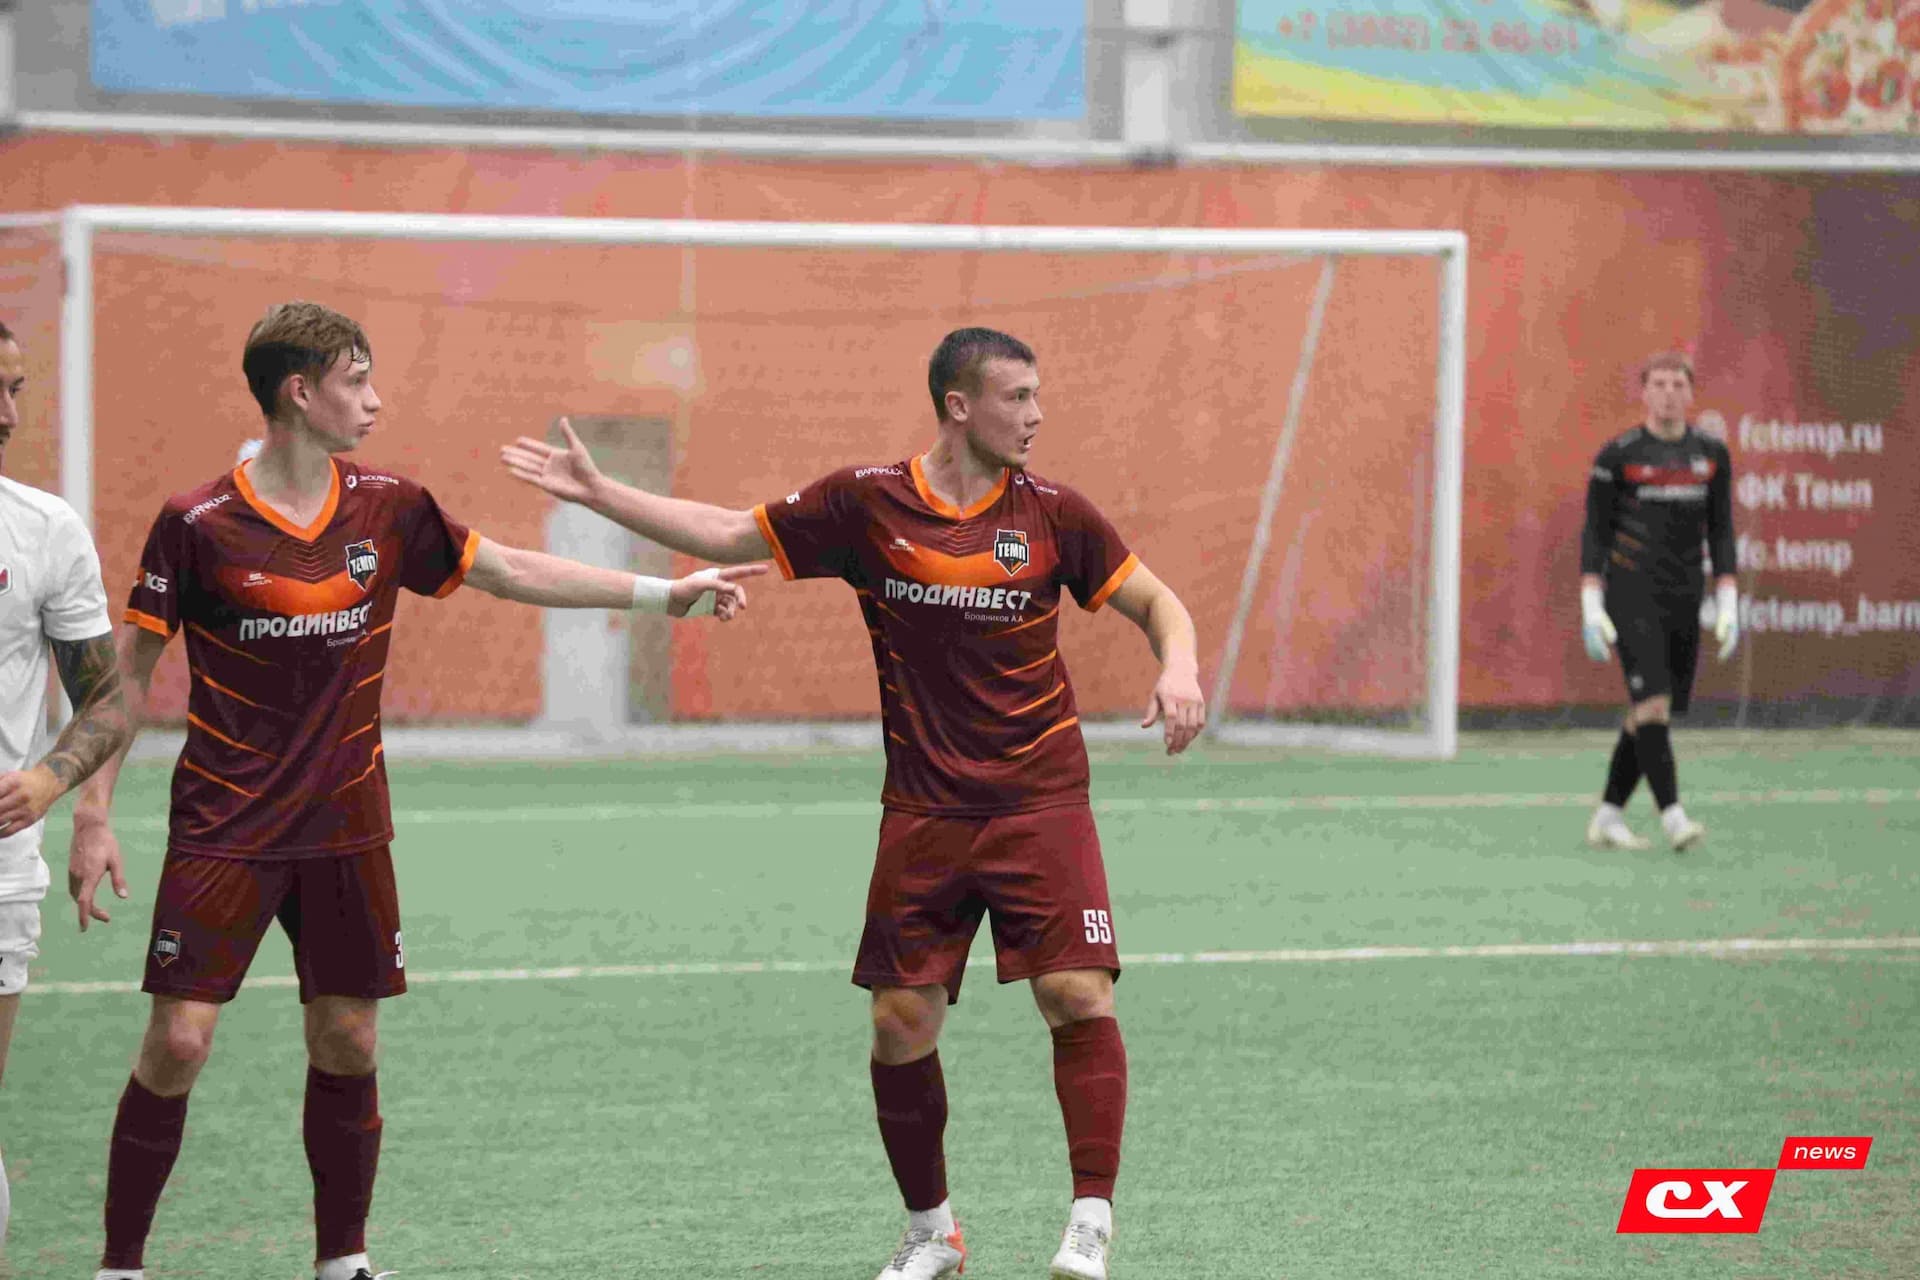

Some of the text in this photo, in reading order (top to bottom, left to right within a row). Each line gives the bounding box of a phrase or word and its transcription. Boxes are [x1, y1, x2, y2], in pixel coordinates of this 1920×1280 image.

[1737, 472, 1787, 509] ФК
[1794, 473, 1873, 509] Темп
[349, 555, 376, 575] ТЕМП
[997, 542, 1026, 561] ТЕМП
[884, 577, 1032, 611] ПРОДИНВЕСТ
[1082, 908, 1112, 945] 55
